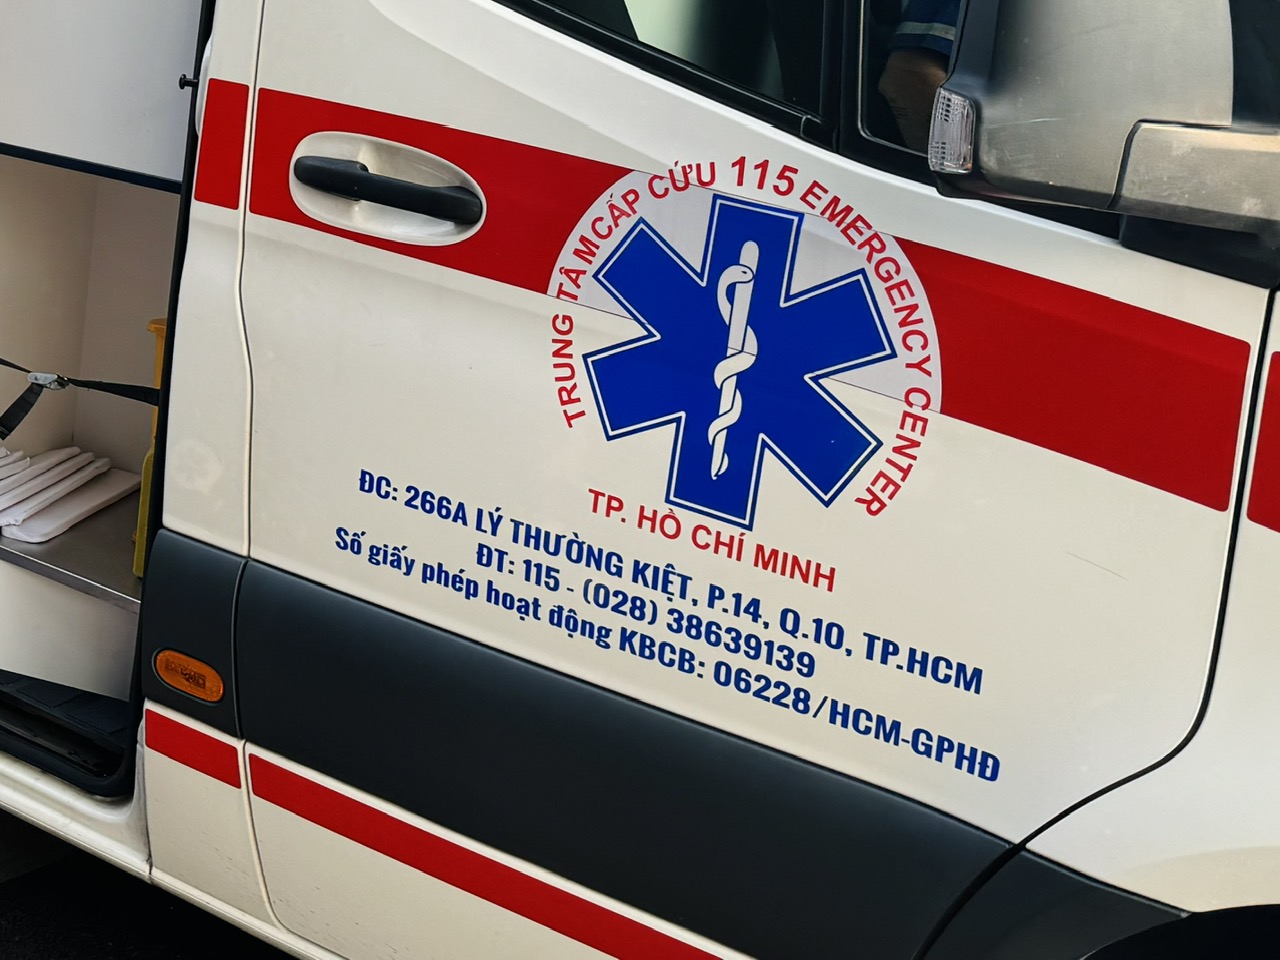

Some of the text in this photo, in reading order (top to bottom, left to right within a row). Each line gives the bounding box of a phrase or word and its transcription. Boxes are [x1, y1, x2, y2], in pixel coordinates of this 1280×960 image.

[551, 155, 933, 517] TRUNG TÂM CẤP CỨU 115 EMERGENCY CENTER
[359, 468, 983, 695] ĐC: 266A LÝ THƯỜNG KIỆT, P.14, Q.10, TP.HCM
[476, 542, 515, 575] ĐT:
[523, 559, 560, 592] 115
[583, 578, 658, 626] (028)
[666, 608, 816, 678] 38639139
[588, 488, 837, 593] TP. HỒ CHÍ MINH
[334, 526, 1001, 783] Số giấy phép hoạt động KBCB: 06228/HCM-GPHĐ
